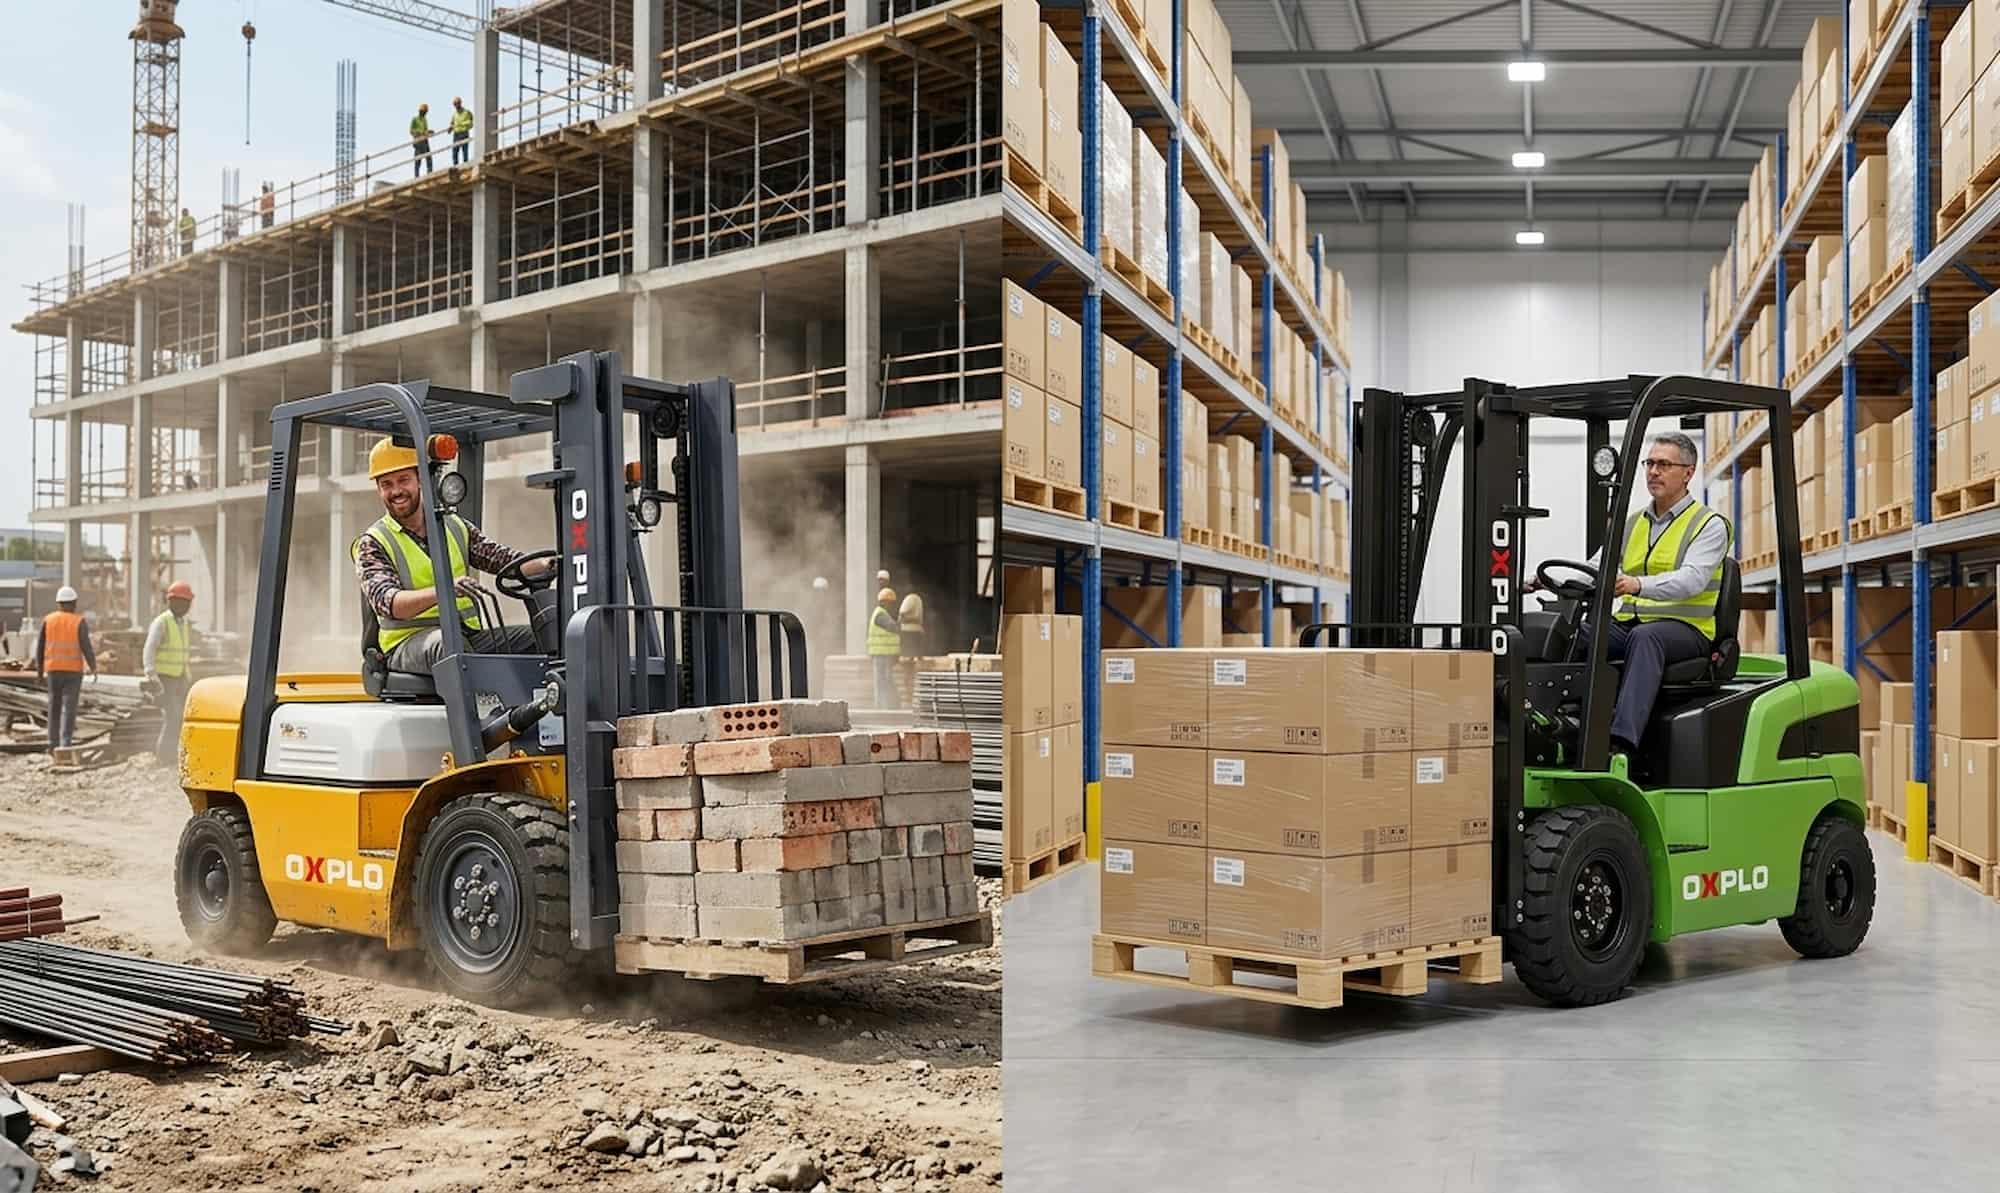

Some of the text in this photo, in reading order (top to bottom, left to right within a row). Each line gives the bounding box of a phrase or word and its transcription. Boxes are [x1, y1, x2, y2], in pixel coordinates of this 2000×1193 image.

[1490, 520, 1510, 655] OXPLO
[285, 853, 383, 890] OXPLO
[1682, 865, 1769, 900] OXPLO
